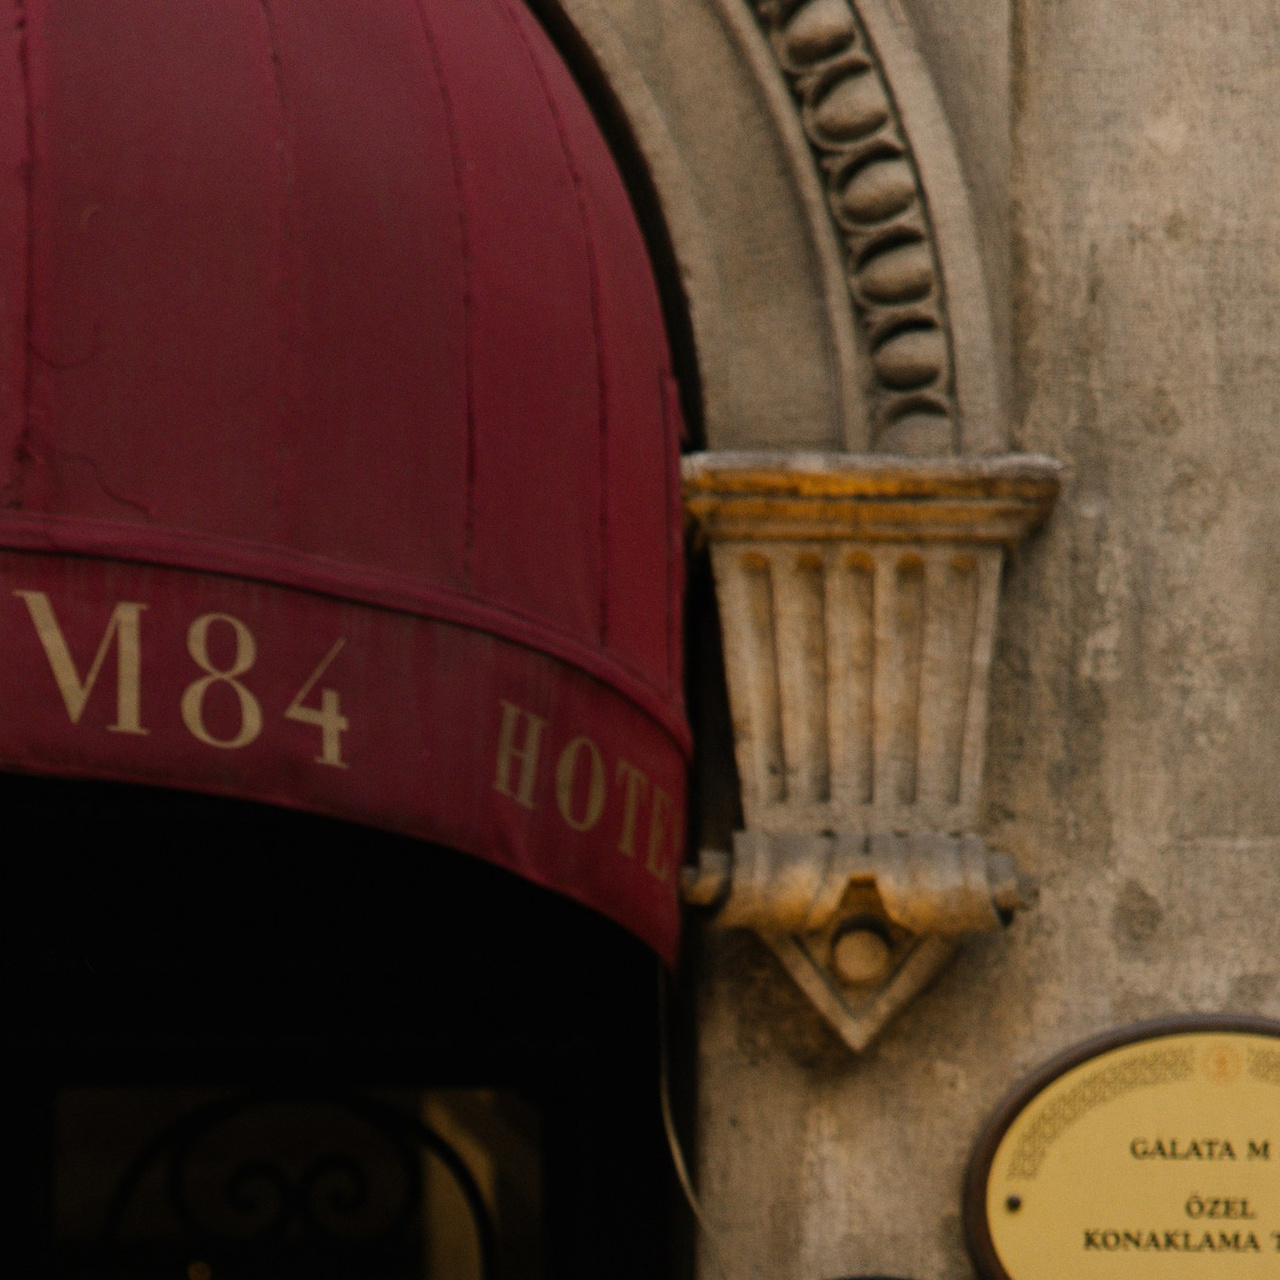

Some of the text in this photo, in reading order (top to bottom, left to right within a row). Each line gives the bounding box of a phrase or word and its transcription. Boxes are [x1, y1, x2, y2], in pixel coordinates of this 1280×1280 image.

[12, 588, 352, 770] M84
[1129, 1137, 1271, 1161] GALATA M
[1184, 1190, 1257, 1221] ÖZEL
[1082, 1228, 1261, 1253] KONAKLAMA
